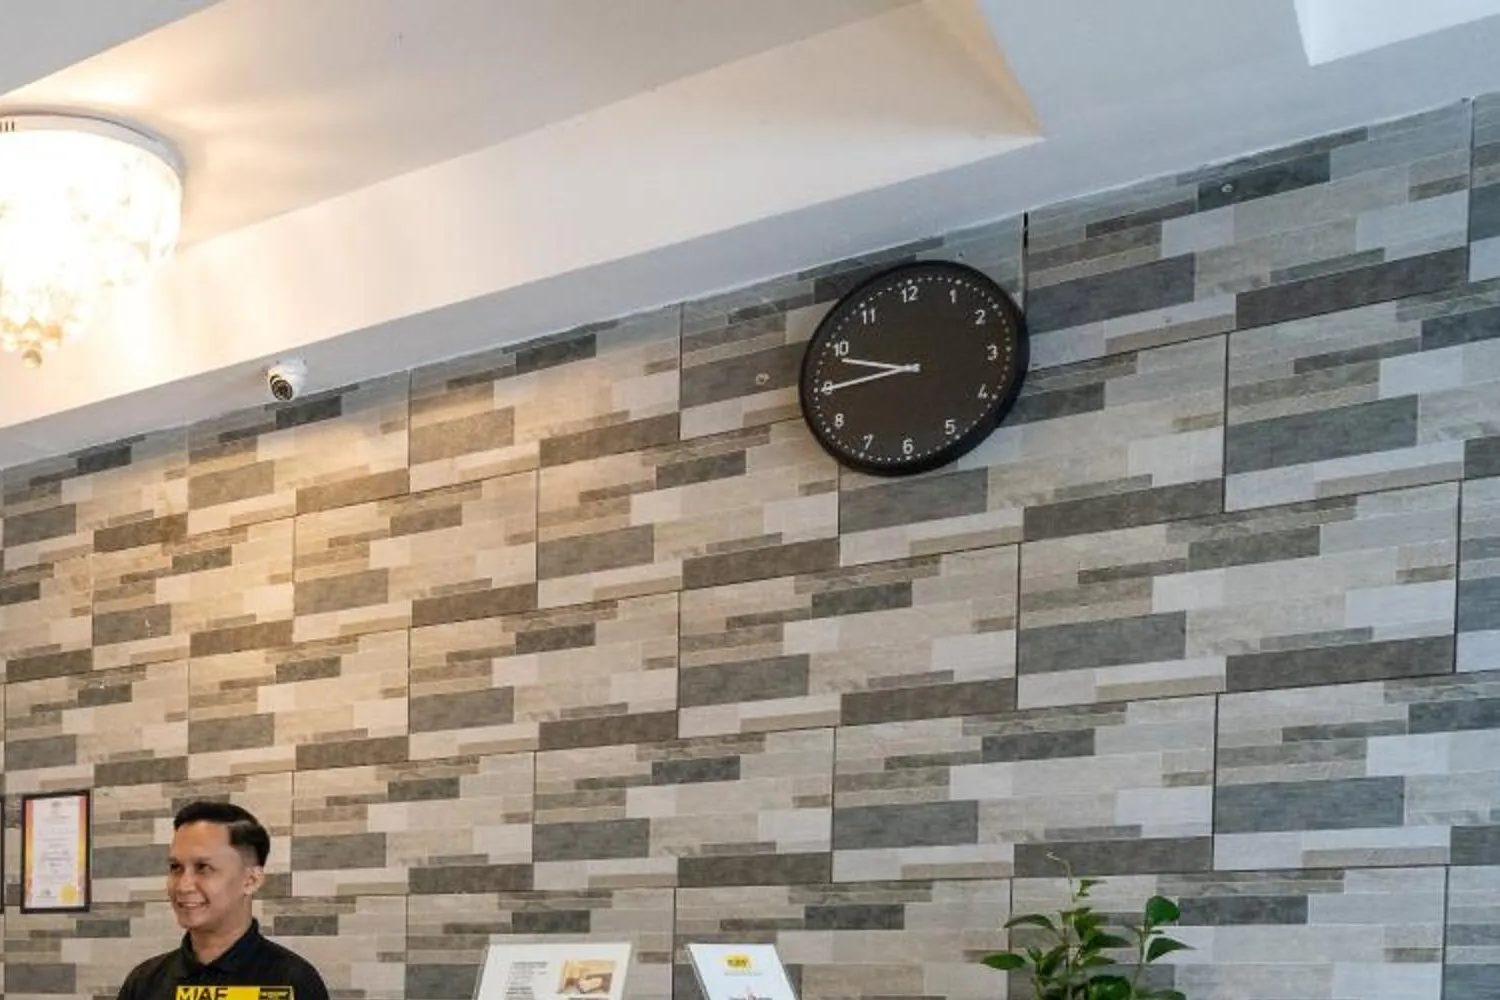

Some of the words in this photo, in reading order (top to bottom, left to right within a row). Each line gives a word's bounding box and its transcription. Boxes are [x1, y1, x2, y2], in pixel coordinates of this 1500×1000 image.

[901, 285, 918, 303] 12
[949, 289, 957, 304] 1
[861, 308, 876, 325] 11
[974, 309, 986, 326] 2
[833, 341, 849, 357] 10
[987, 345, 998, 361] 3
[977, 386, 989, 400] 4
[834, 413, 844, 428] 8
[945, 419, 956, 436] 5
[862, 434, 874, 451] 7
[902, 438, 913, 454] 6
